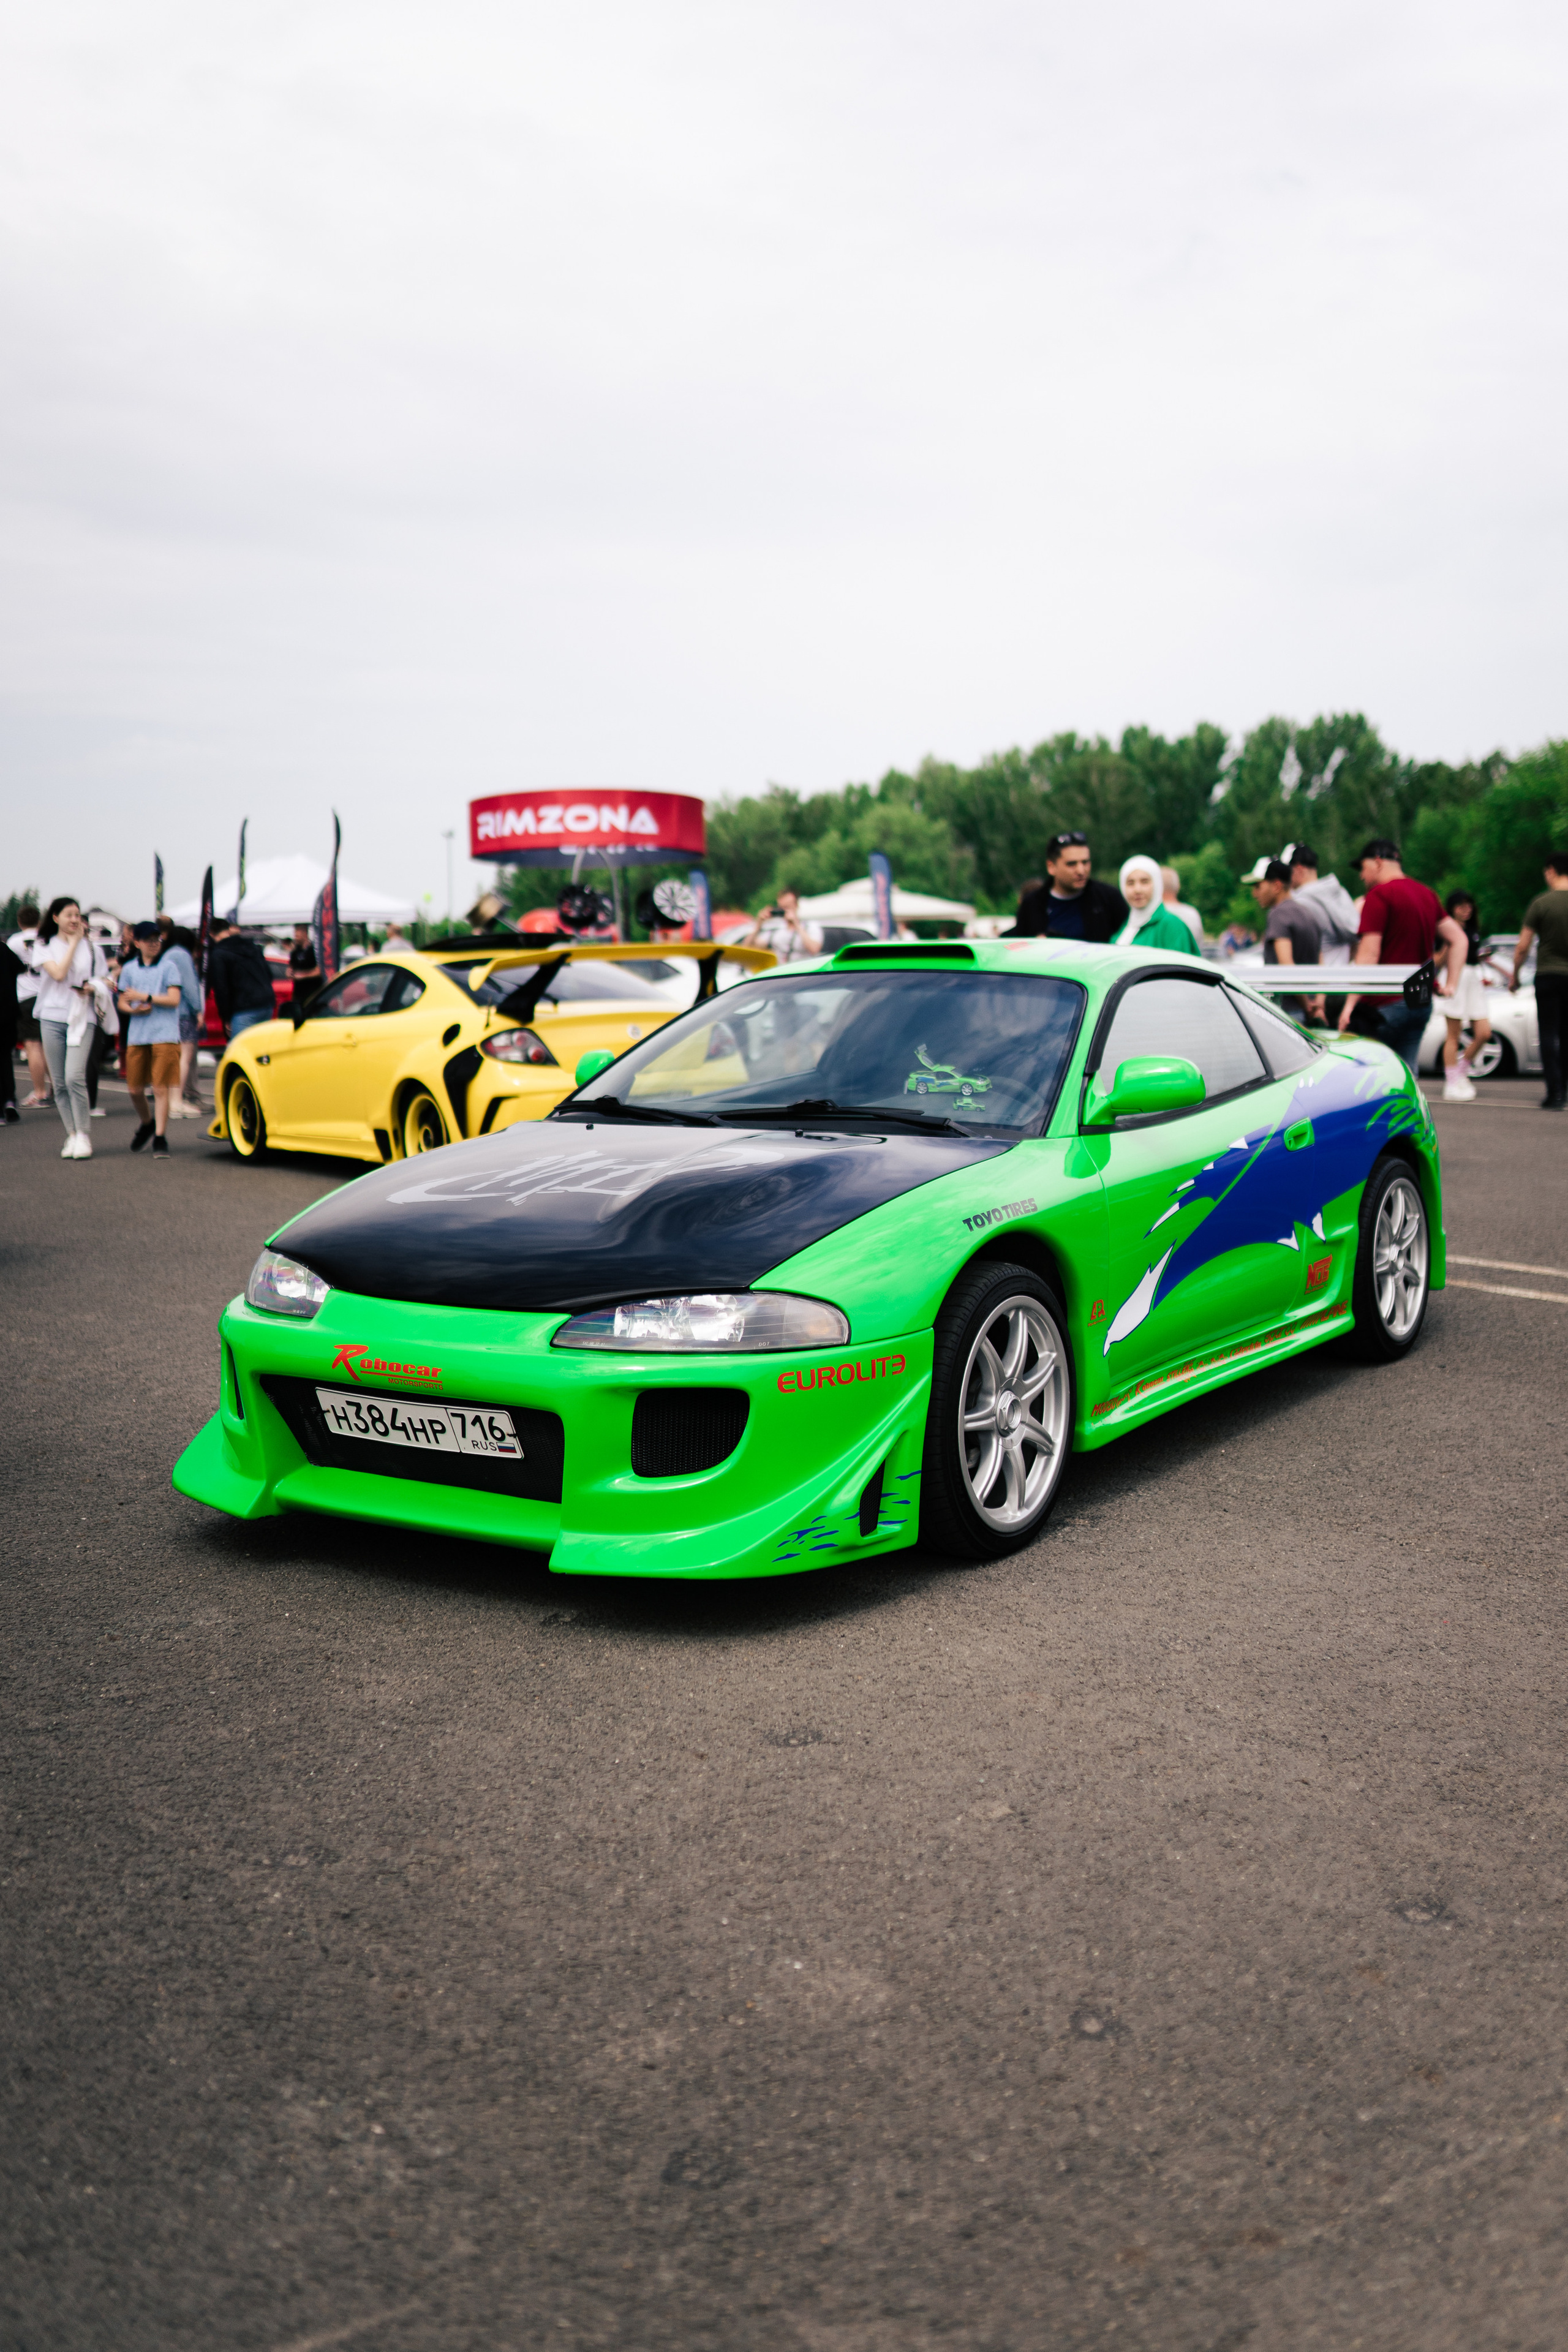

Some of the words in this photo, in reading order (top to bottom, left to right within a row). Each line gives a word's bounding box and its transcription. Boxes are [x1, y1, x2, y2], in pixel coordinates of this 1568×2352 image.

[477, 804, 659, 841] RIMZONA
[962, 1208, 1004, 1232] TOYO
[1001, 1198, 1038, 1219] TIRES
[1306, 1253, 1333, 1289] NOS
[331, 1344, 442, 1382] Robocar
[388, 1378, 444, 1390] MOTORSPORTS
[450, 1412, 506, 1441] 716
[471, 1440, 497, 1452] RUS
